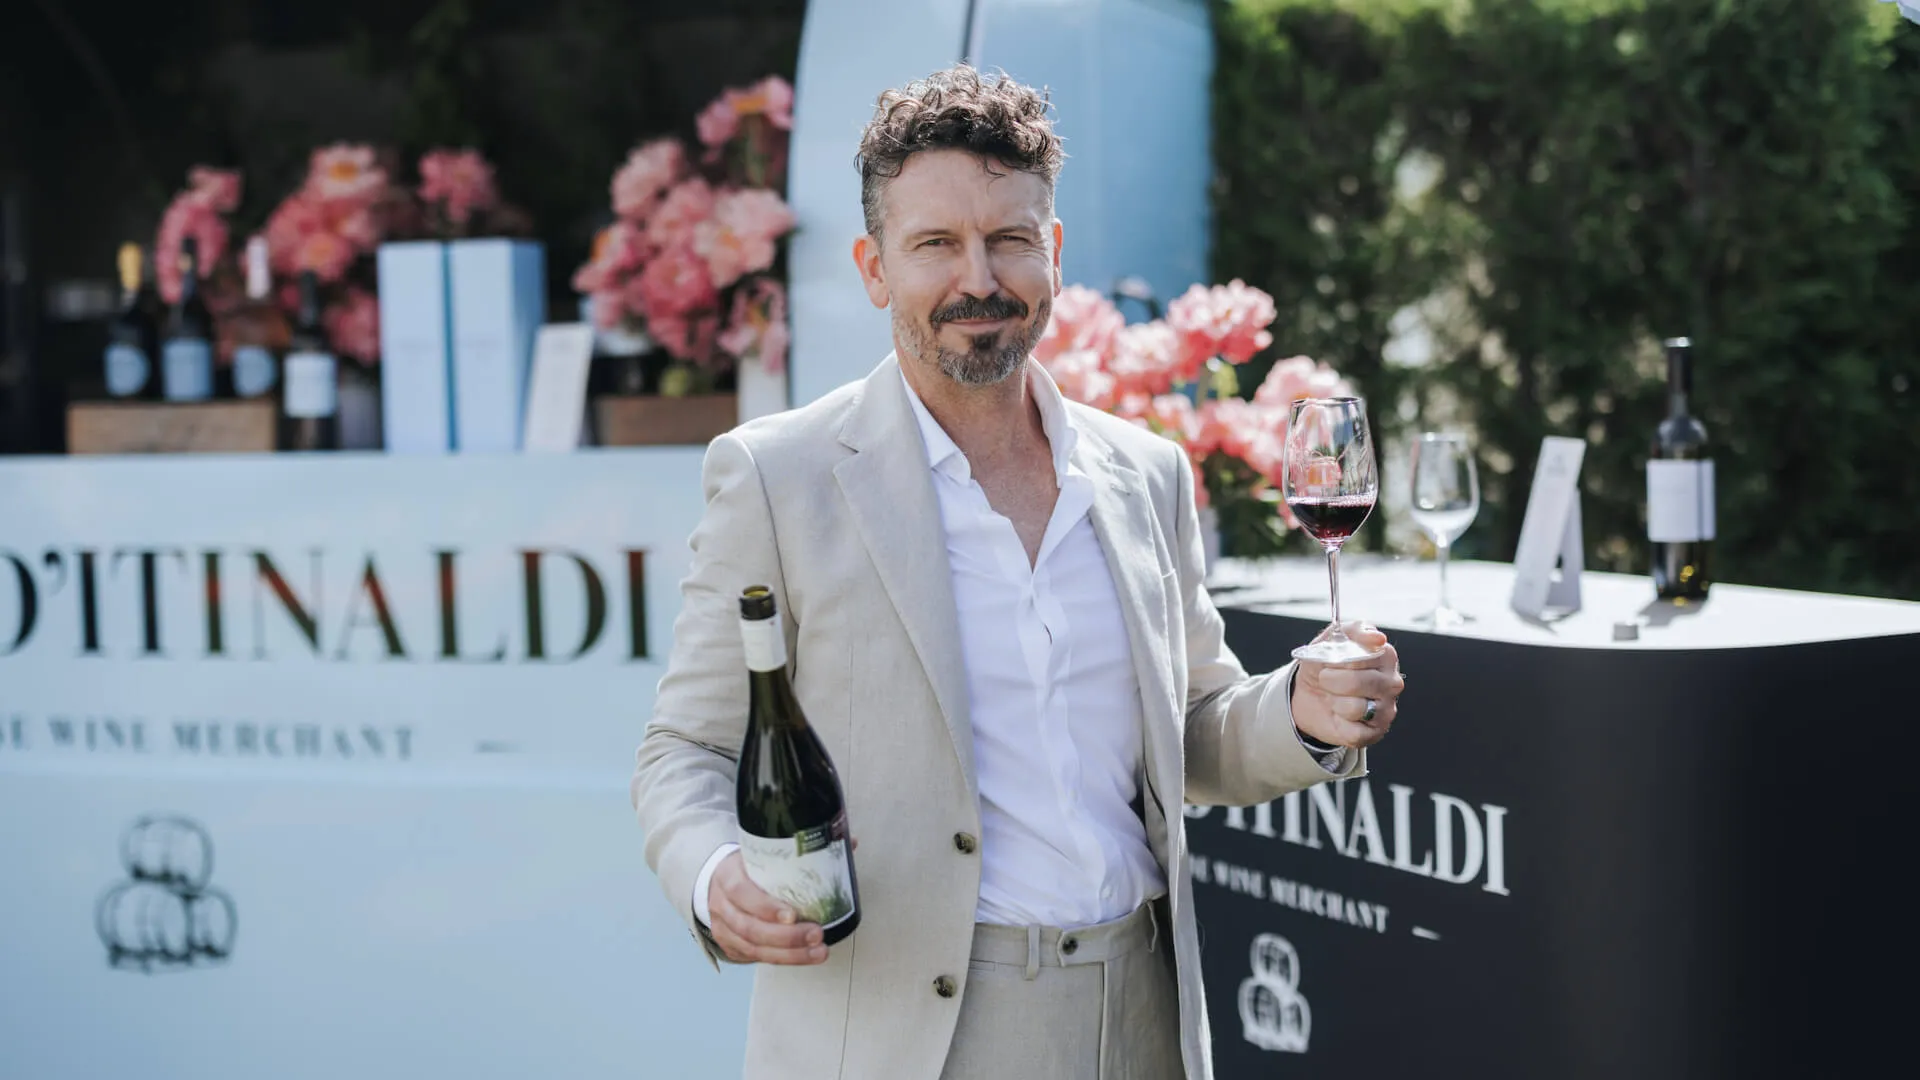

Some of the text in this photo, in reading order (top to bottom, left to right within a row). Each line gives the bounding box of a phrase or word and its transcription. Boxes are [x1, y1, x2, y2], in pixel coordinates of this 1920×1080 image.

[48, 716, 148, 753] WINE
[172, 719, 412, 760] MERCHANT
[1269, 876, 1389, 934] MERCHANT
